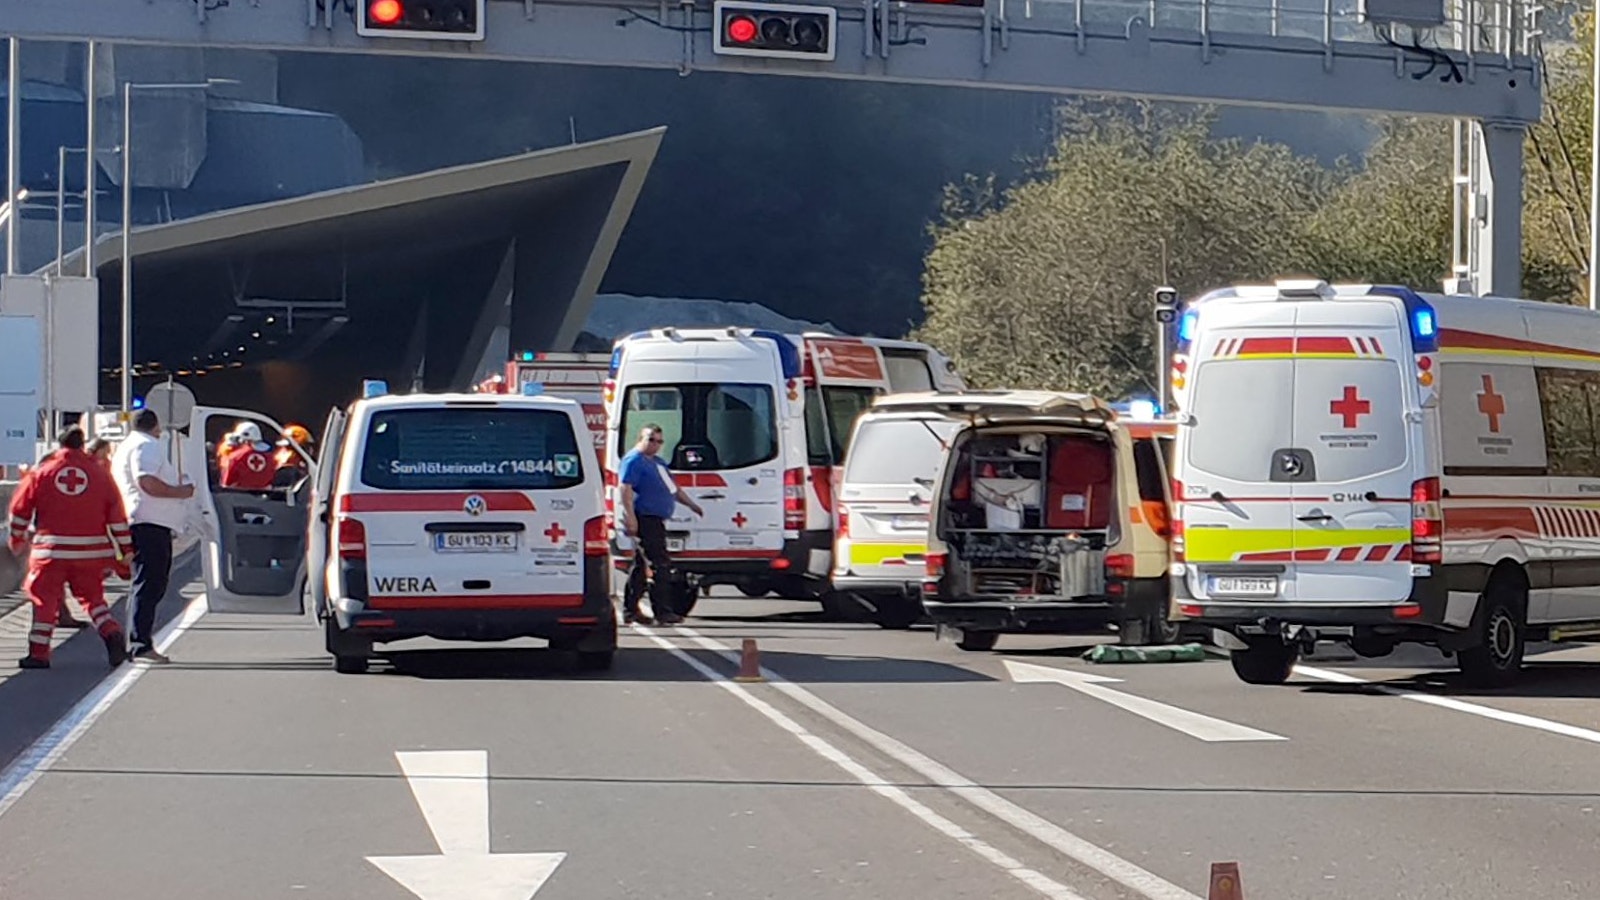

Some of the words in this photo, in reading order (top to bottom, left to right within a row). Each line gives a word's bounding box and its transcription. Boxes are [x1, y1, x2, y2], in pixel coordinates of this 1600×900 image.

[390, 460, 497, 474] Sanitätseinsatz
[510, 460, 553, 473] 14844
[374, 576, 437, 592] WERA
